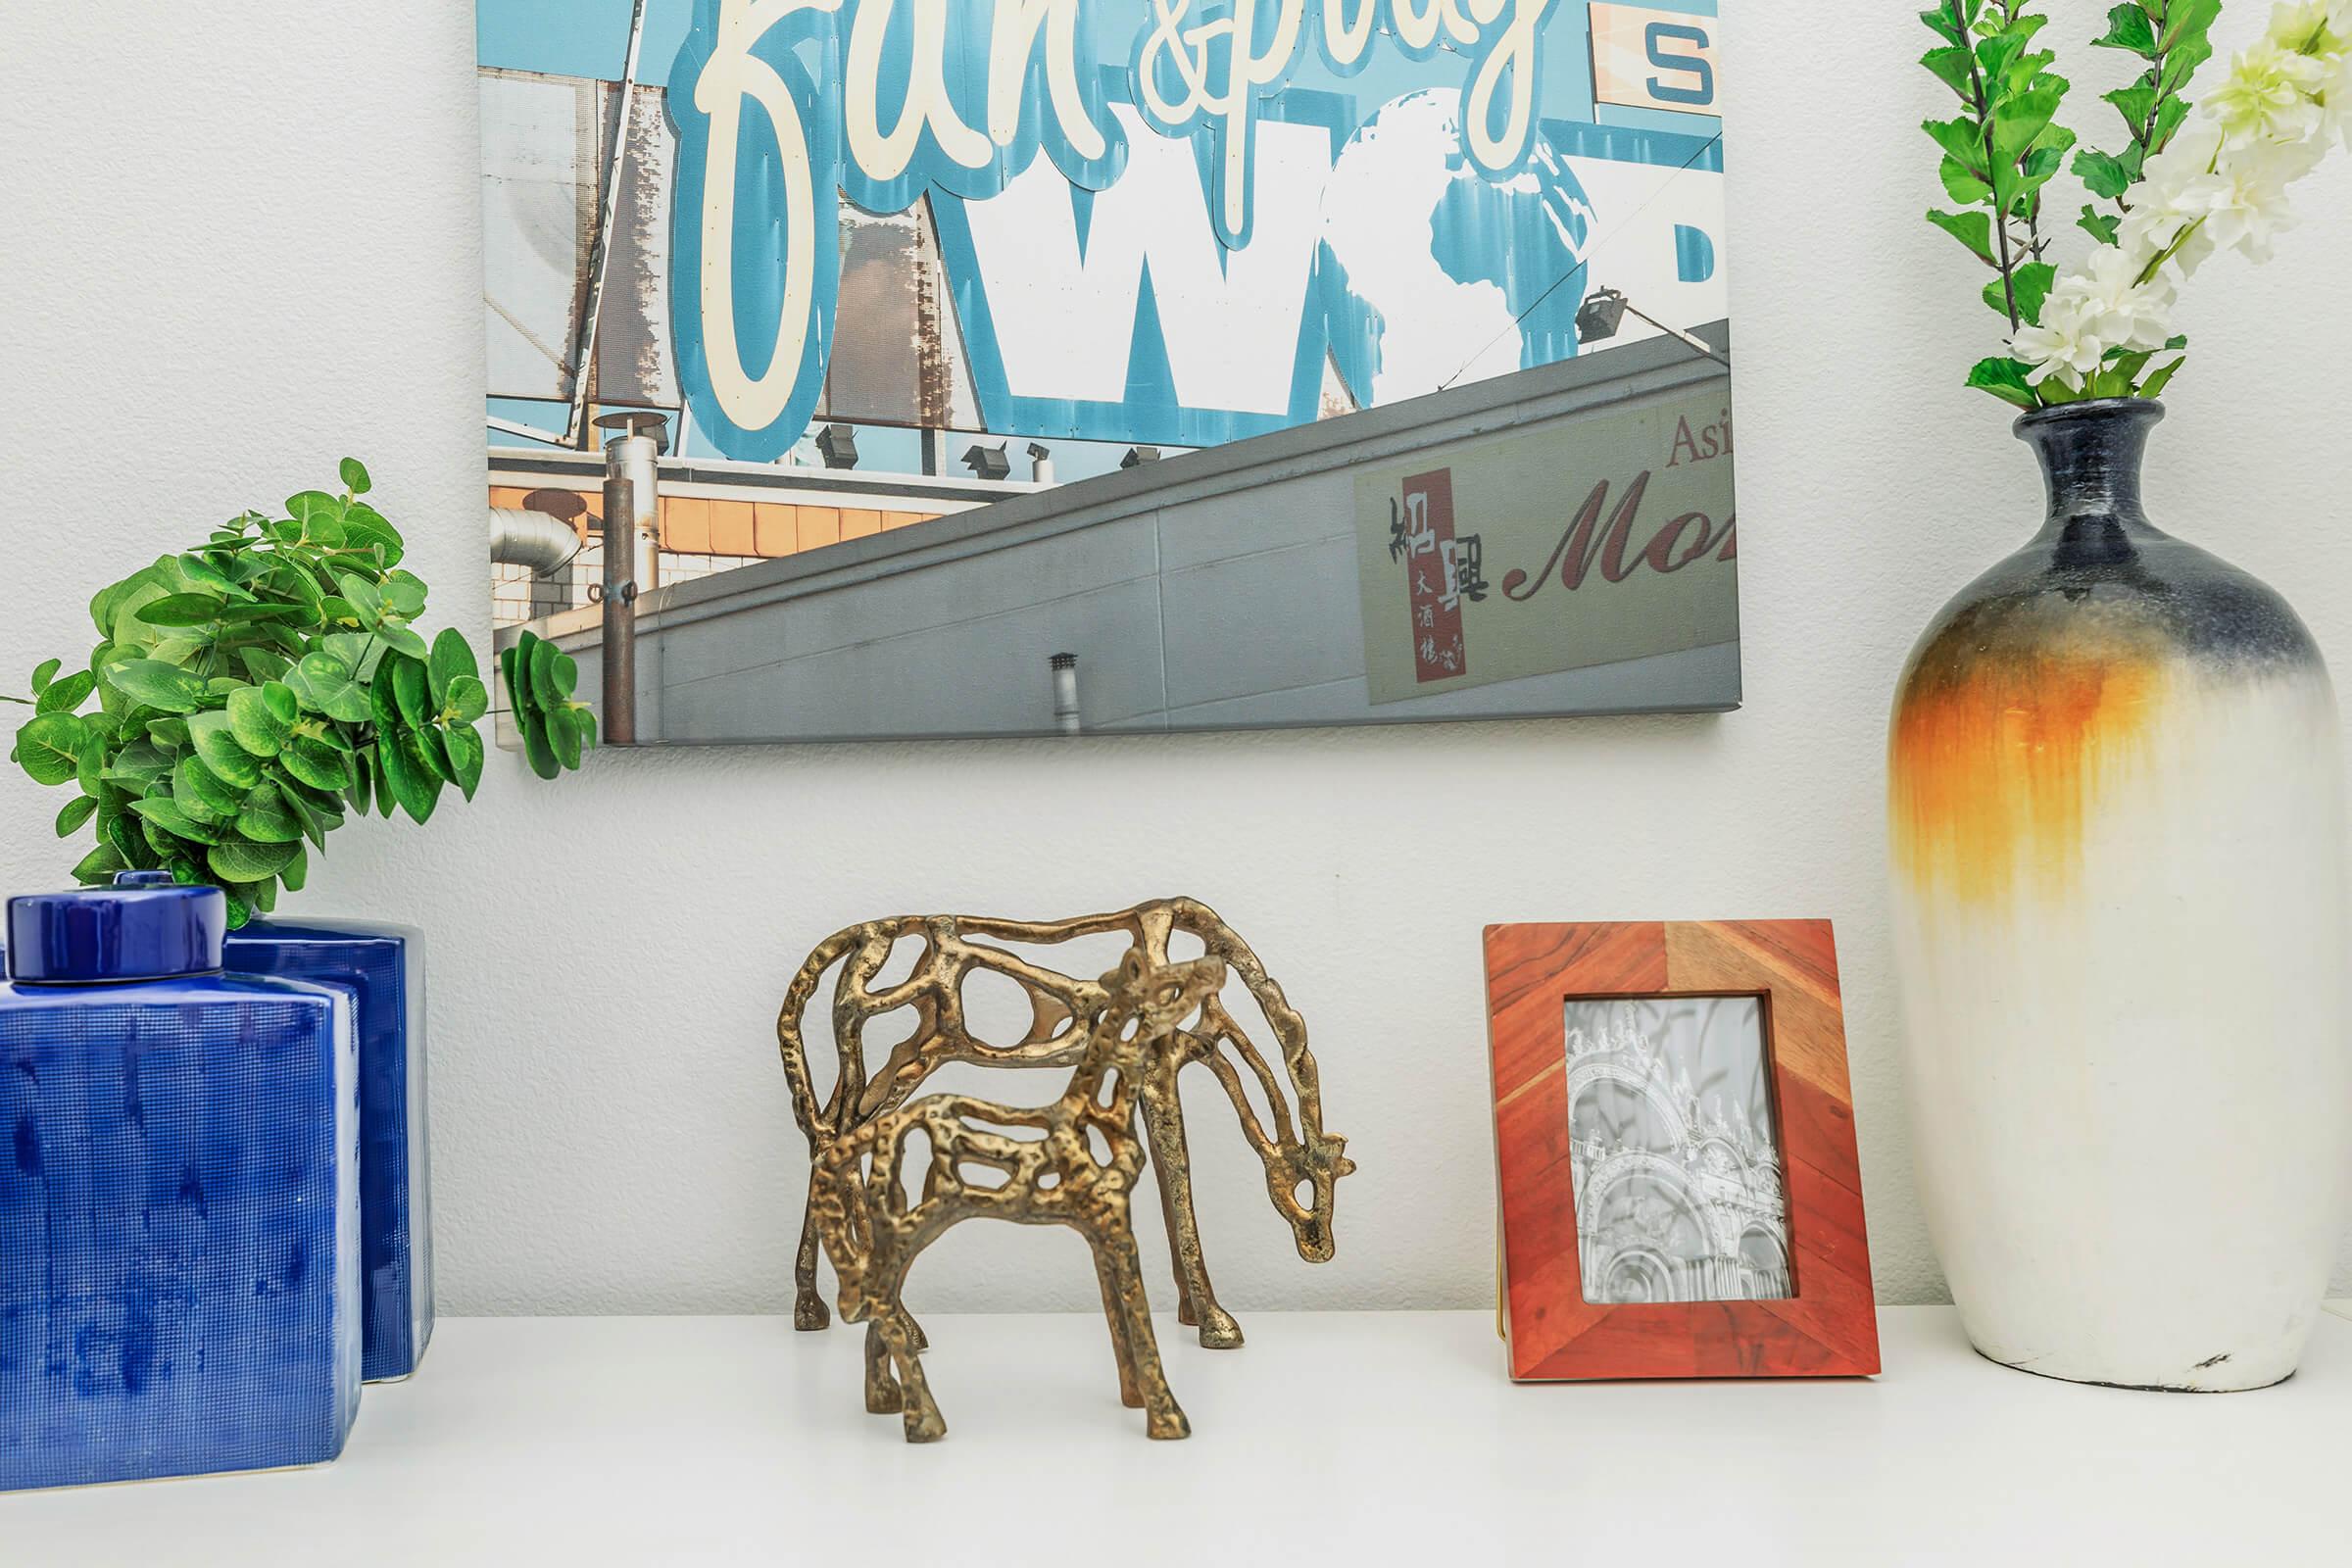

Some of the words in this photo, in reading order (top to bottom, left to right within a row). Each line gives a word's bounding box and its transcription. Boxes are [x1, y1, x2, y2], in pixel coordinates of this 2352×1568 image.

[1140, 0, 1235, 124] &
[1644, 22, 1714, 106] S
[1666, 408, 1733, 467] Asi
